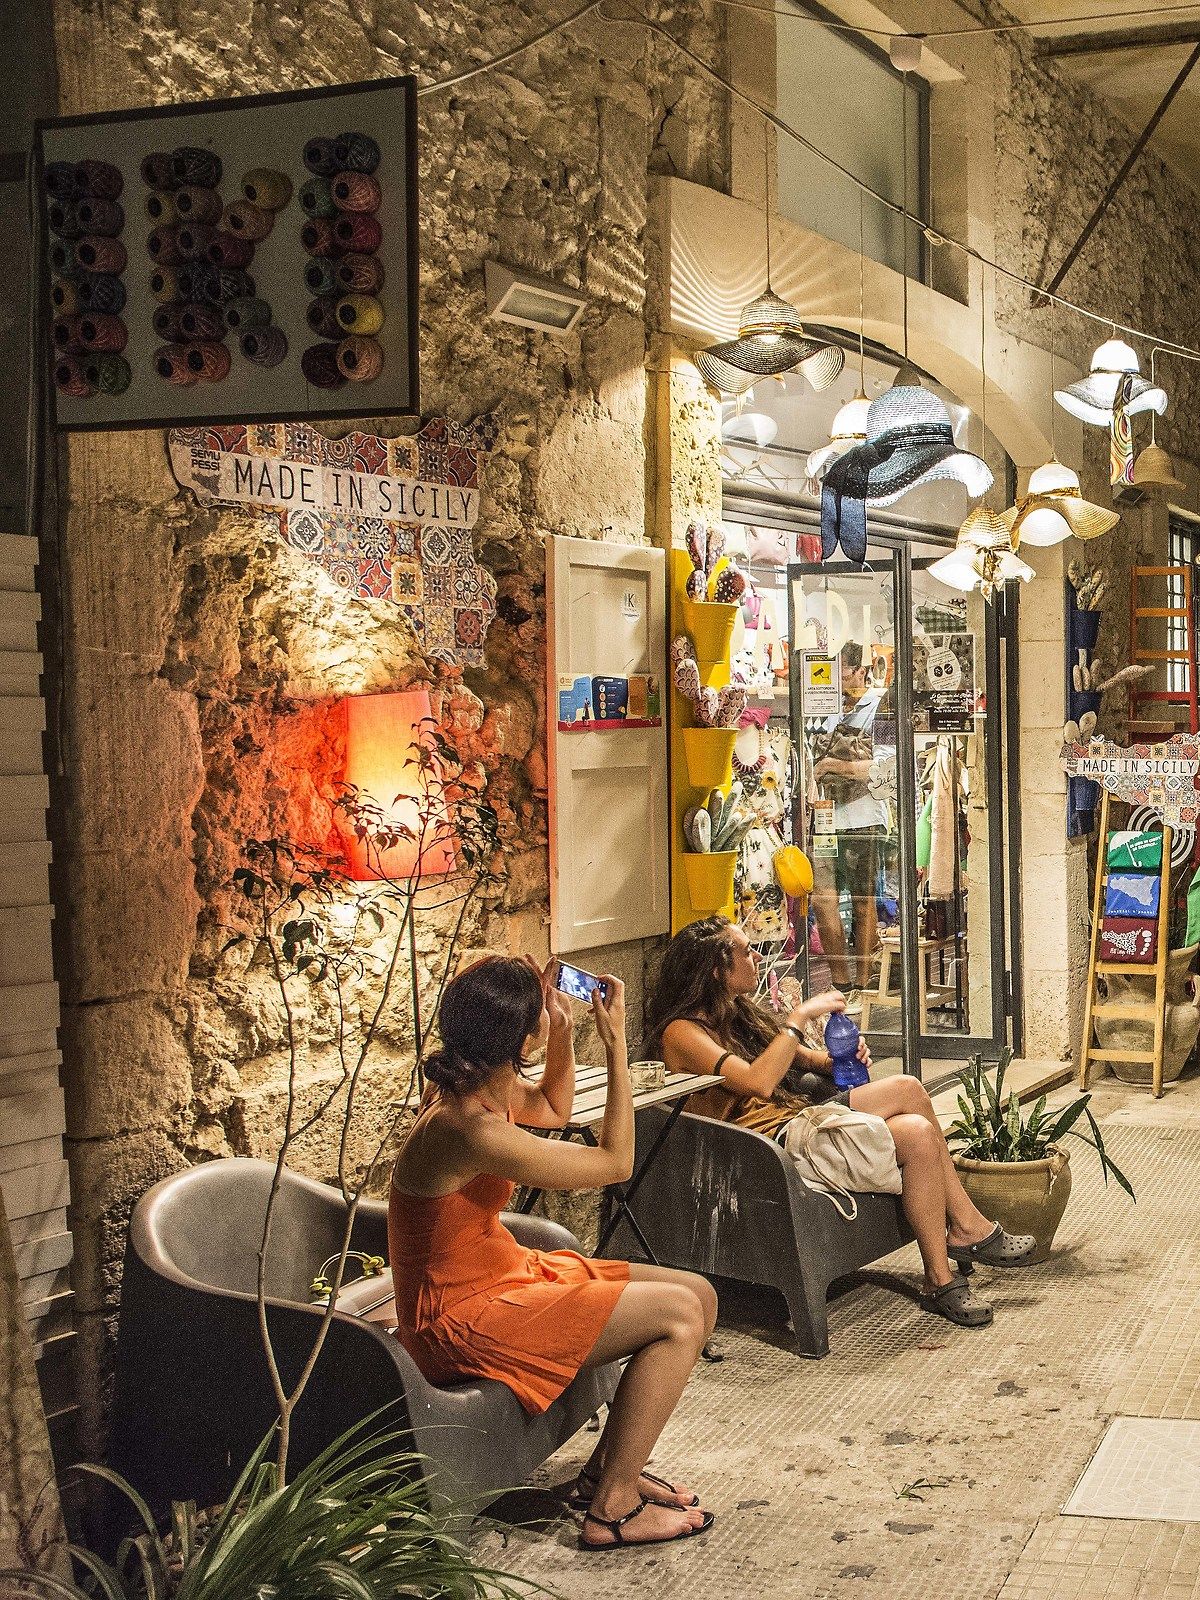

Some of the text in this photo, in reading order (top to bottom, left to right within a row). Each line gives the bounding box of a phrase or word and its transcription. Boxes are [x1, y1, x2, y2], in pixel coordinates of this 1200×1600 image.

[190, 448, 221, 461] SEMU
[191, 459, 220, 471] PESSI
[234, 458, 473, 523] MADE IN SICILY
[1083, 759, 1116, 773] MADE
[1123, 760, 1139, 773] IN
[1145, 760, 1195, 774] SICILY
